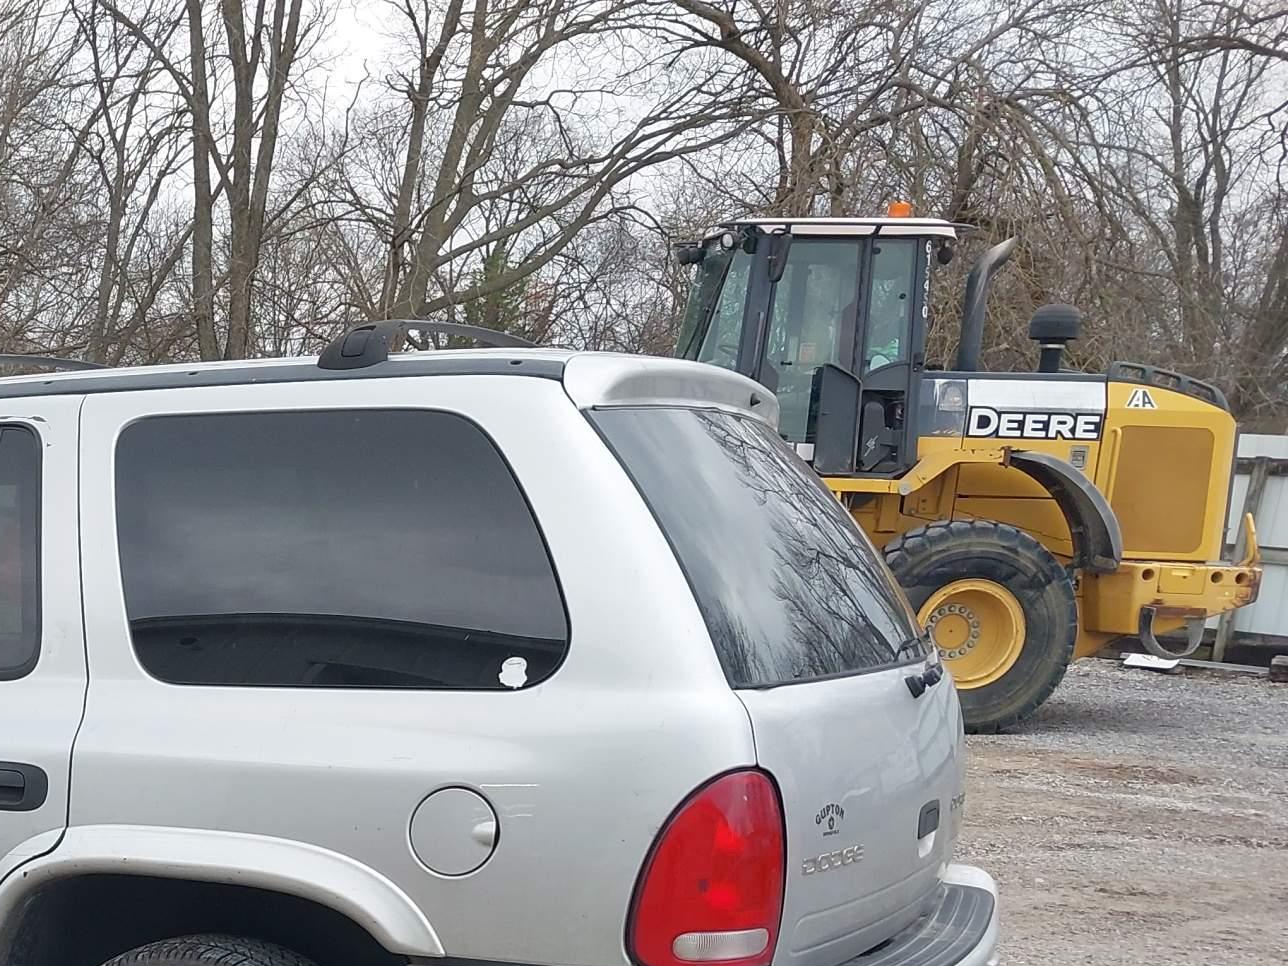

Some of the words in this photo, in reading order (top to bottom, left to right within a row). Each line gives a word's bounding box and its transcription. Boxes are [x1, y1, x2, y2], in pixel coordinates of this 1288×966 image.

[967, 407, 1101, 439] DEERE
[815, 803, 845, 825] GUPTON
[801, 843, 865, 876] DODGE
